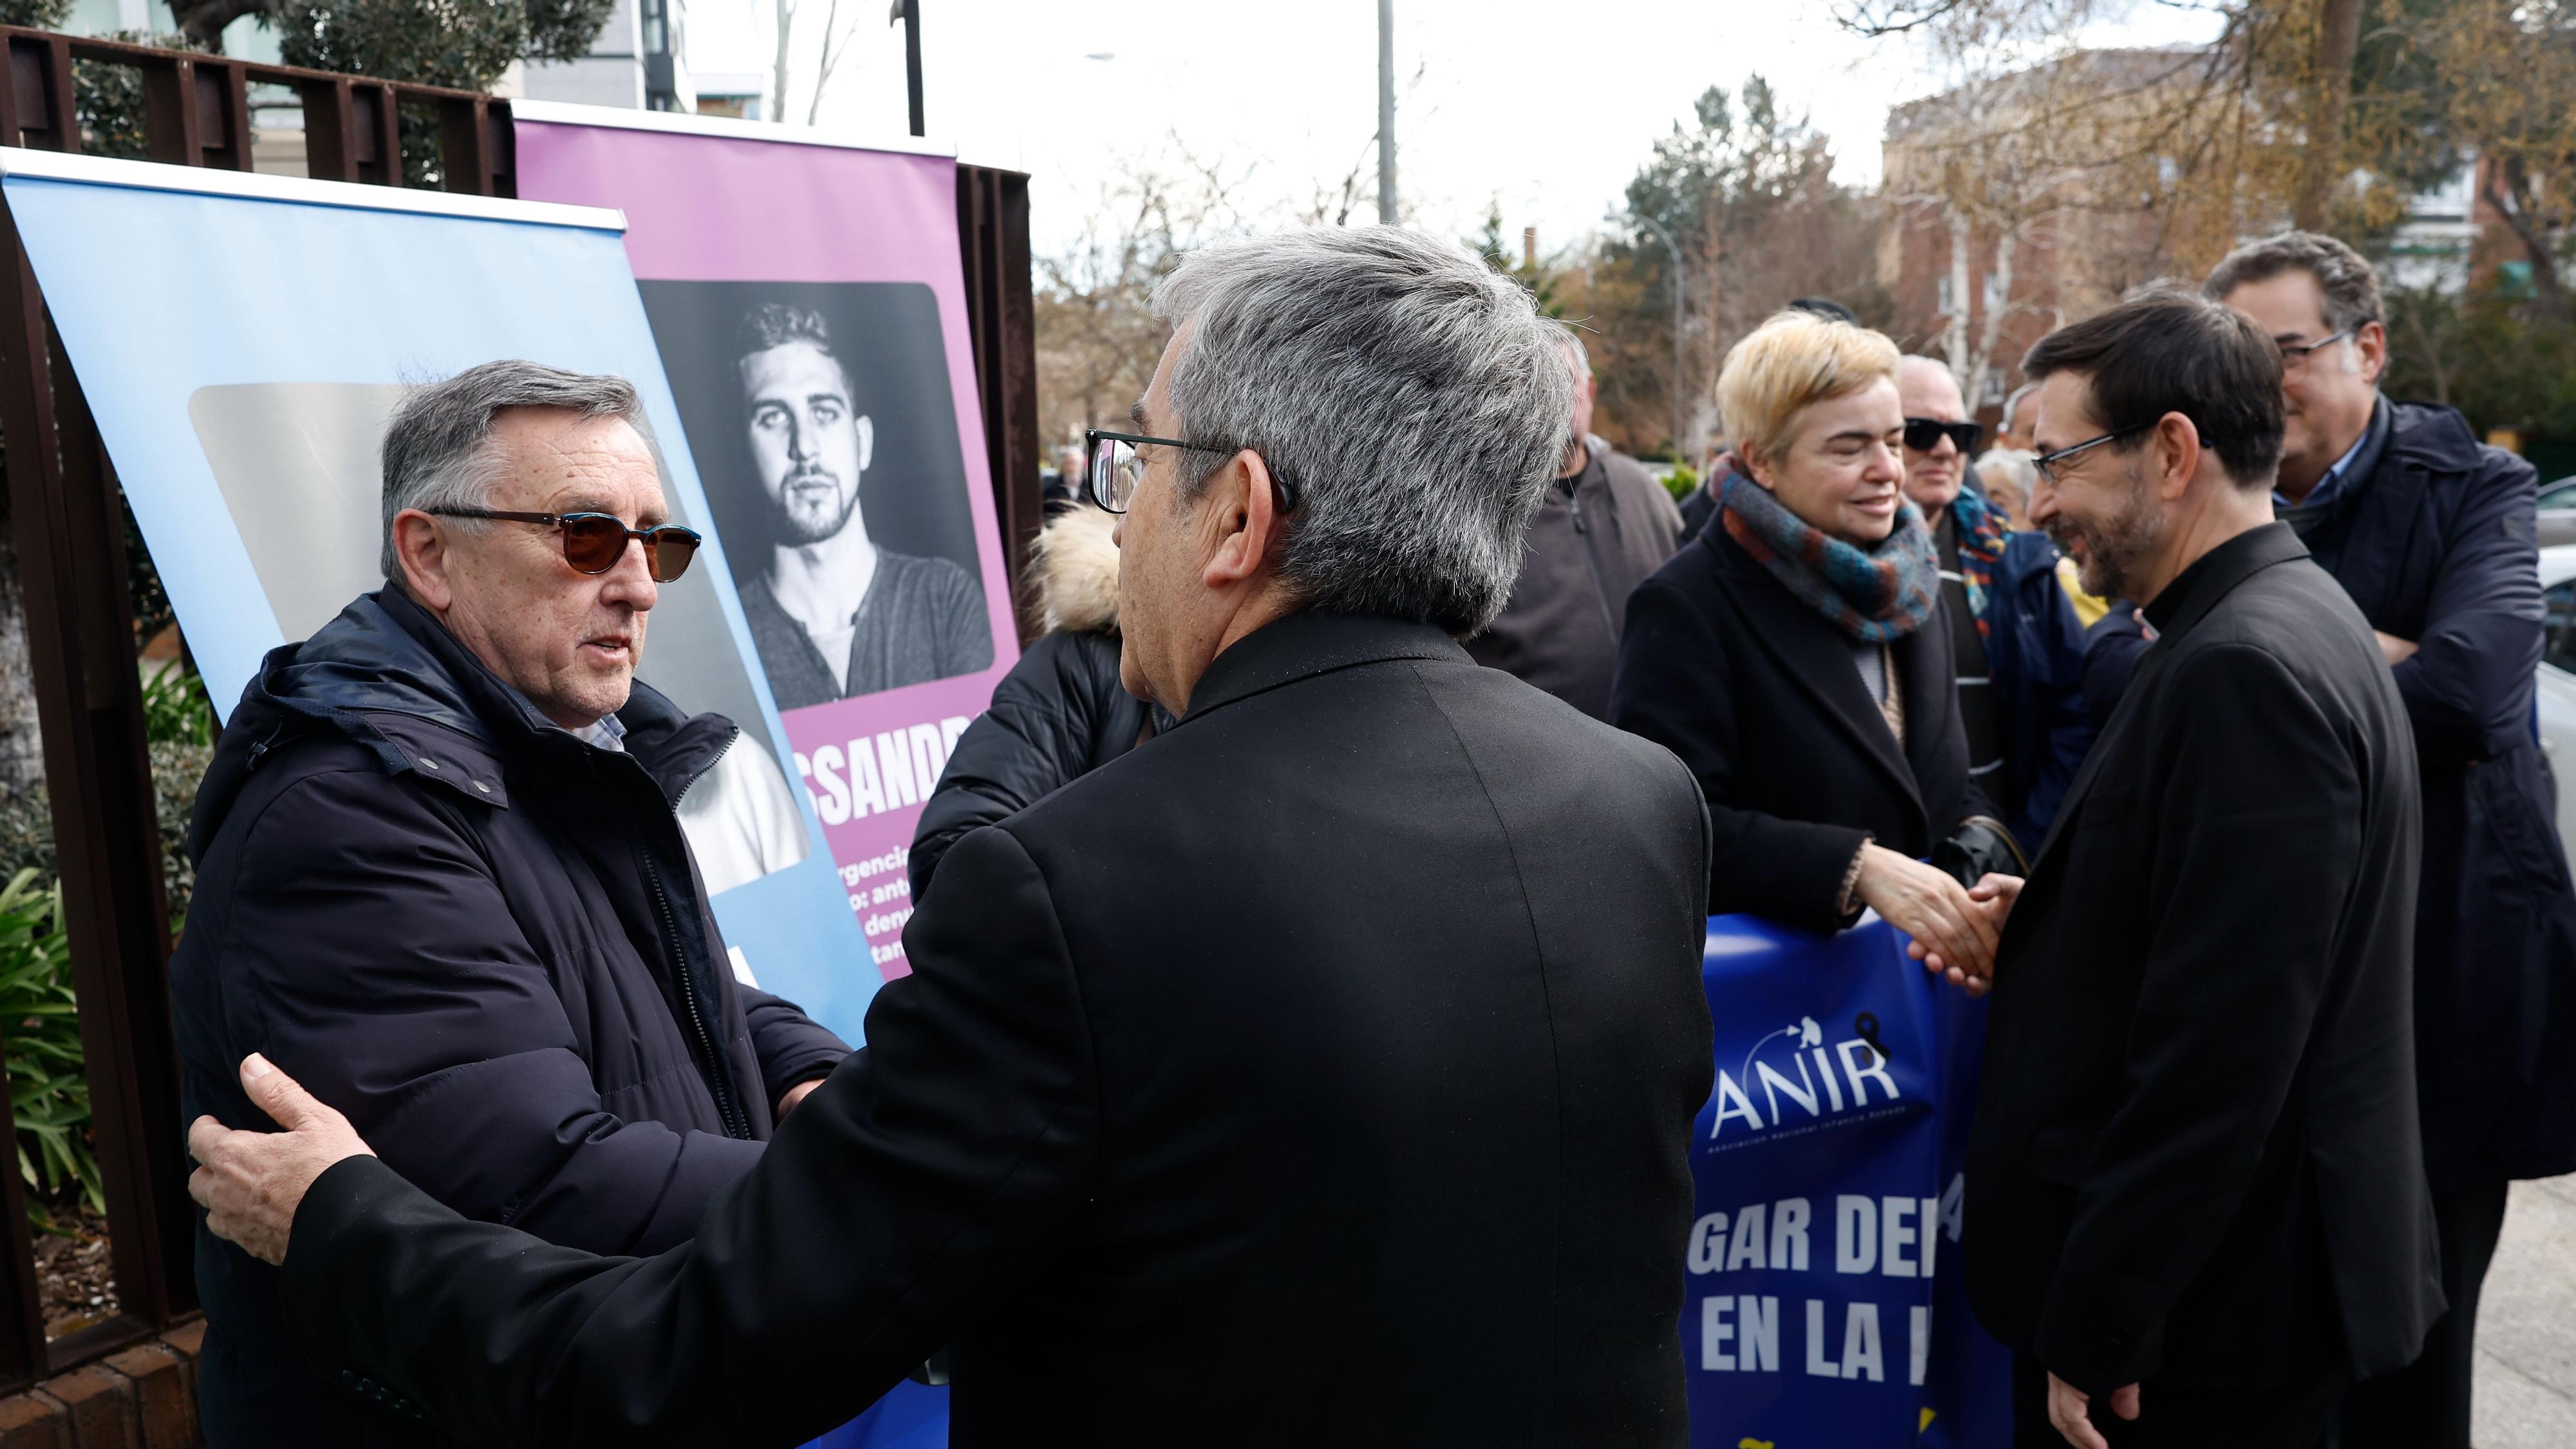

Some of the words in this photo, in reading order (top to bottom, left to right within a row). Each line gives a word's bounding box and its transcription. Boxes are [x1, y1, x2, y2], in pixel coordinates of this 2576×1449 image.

[1710, 1037, 1900, 1140] ANIR
[1687, 1197, 1812, 1276] GAR
[1701, 1294, 1780, 1372] EN
[1806, 1298, 1885, 1383] LA
